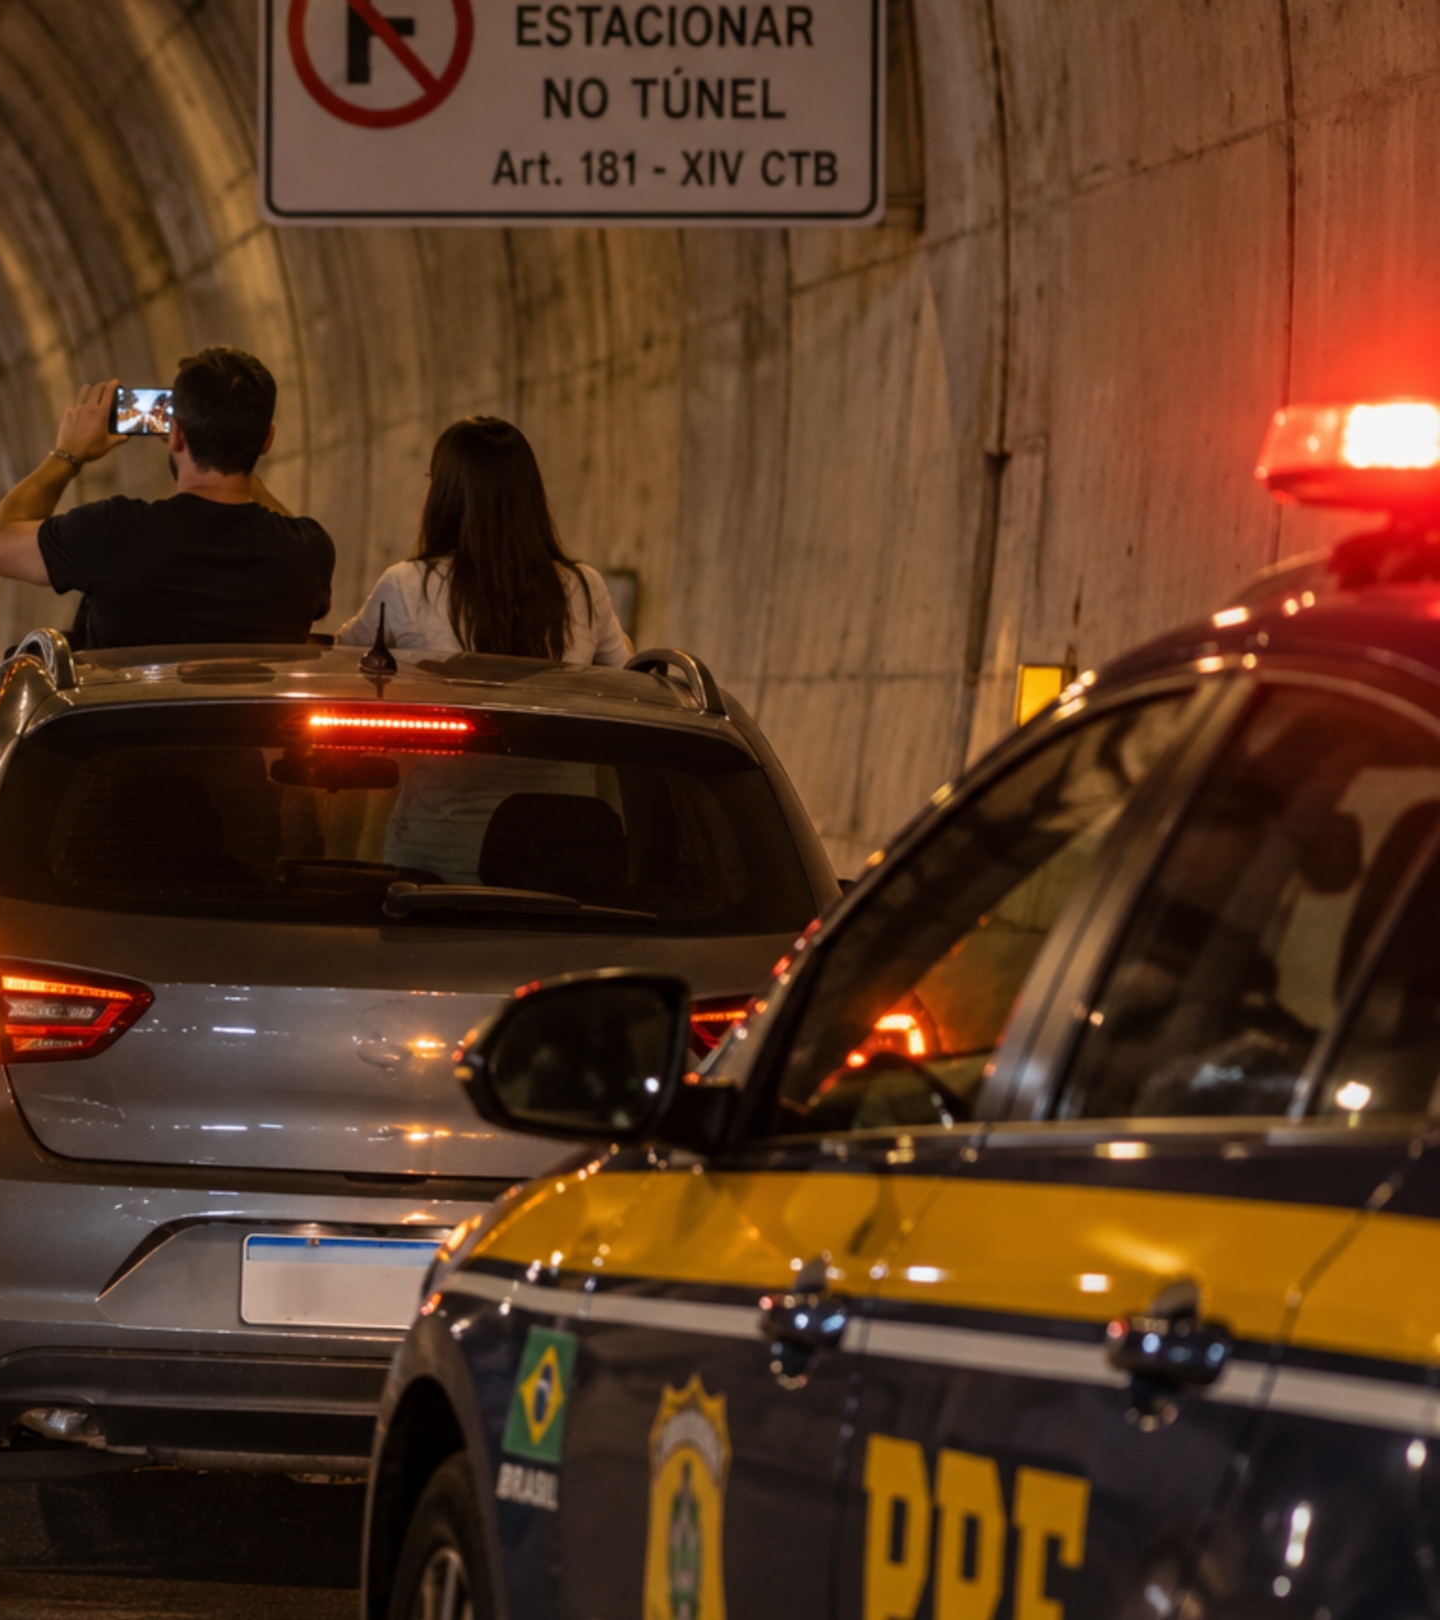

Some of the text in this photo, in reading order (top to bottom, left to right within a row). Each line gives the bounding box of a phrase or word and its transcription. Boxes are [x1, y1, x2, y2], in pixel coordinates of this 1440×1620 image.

[515, 4, 815, 48] ESTACIONAR
[542, 66, 788, 120] NO TÚNEL
[491, 149, 840, 188] Art. 181 - XIV CTB
[495, 1461, 559, 1511] BRASIL
